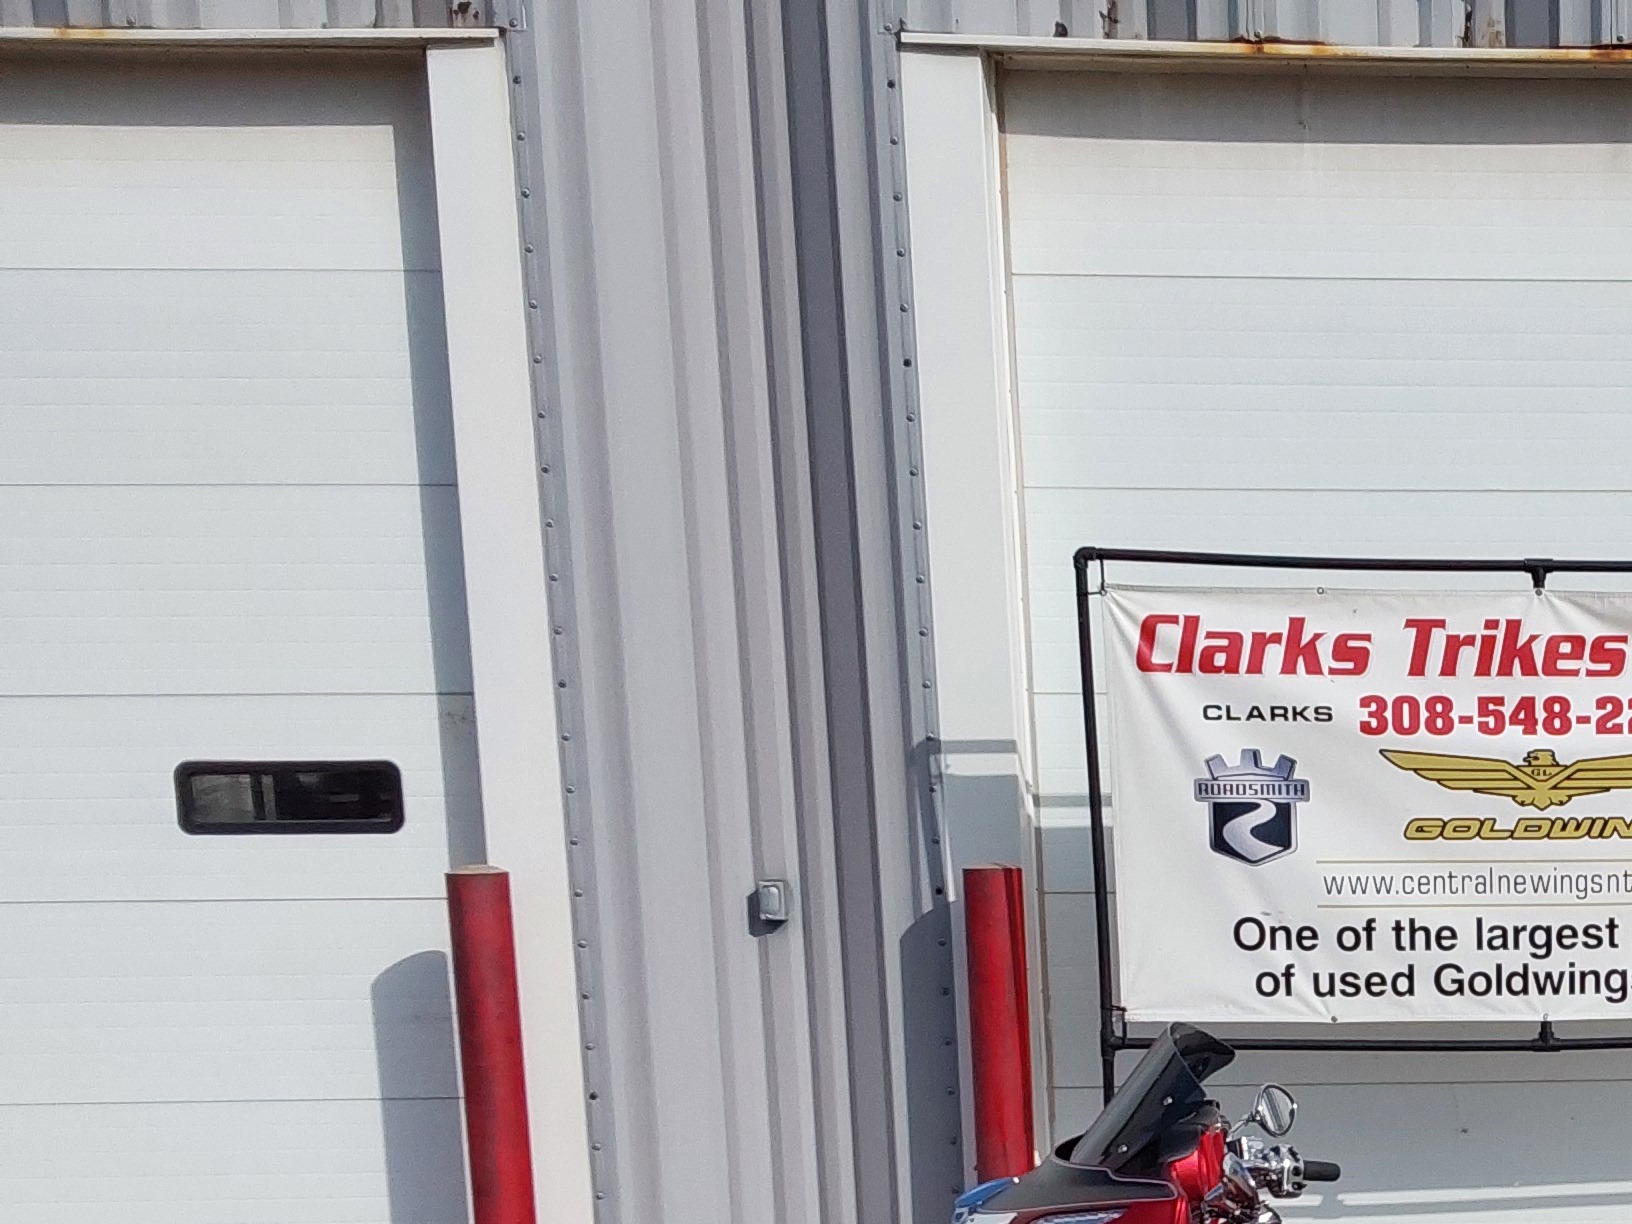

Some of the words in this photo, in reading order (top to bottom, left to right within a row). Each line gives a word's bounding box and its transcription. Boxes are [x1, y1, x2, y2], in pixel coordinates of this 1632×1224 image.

[1136, 613, 1372, 677] Clarks
[1405, 618, 1628, 678] Trikes
[1202, 704, 1334, 723] CLARKS
[1198, 782, 1306, 797] ROADSMITH
[1233, 916, 1319, 952] One
[1336, 917, 1377, 952] of
[1391, 917, 1459, 952] the
[1475, 916, 1620, 960] largest
[1255, 963, 1296, 998] of
[1312, 963, 1416, 998] used
